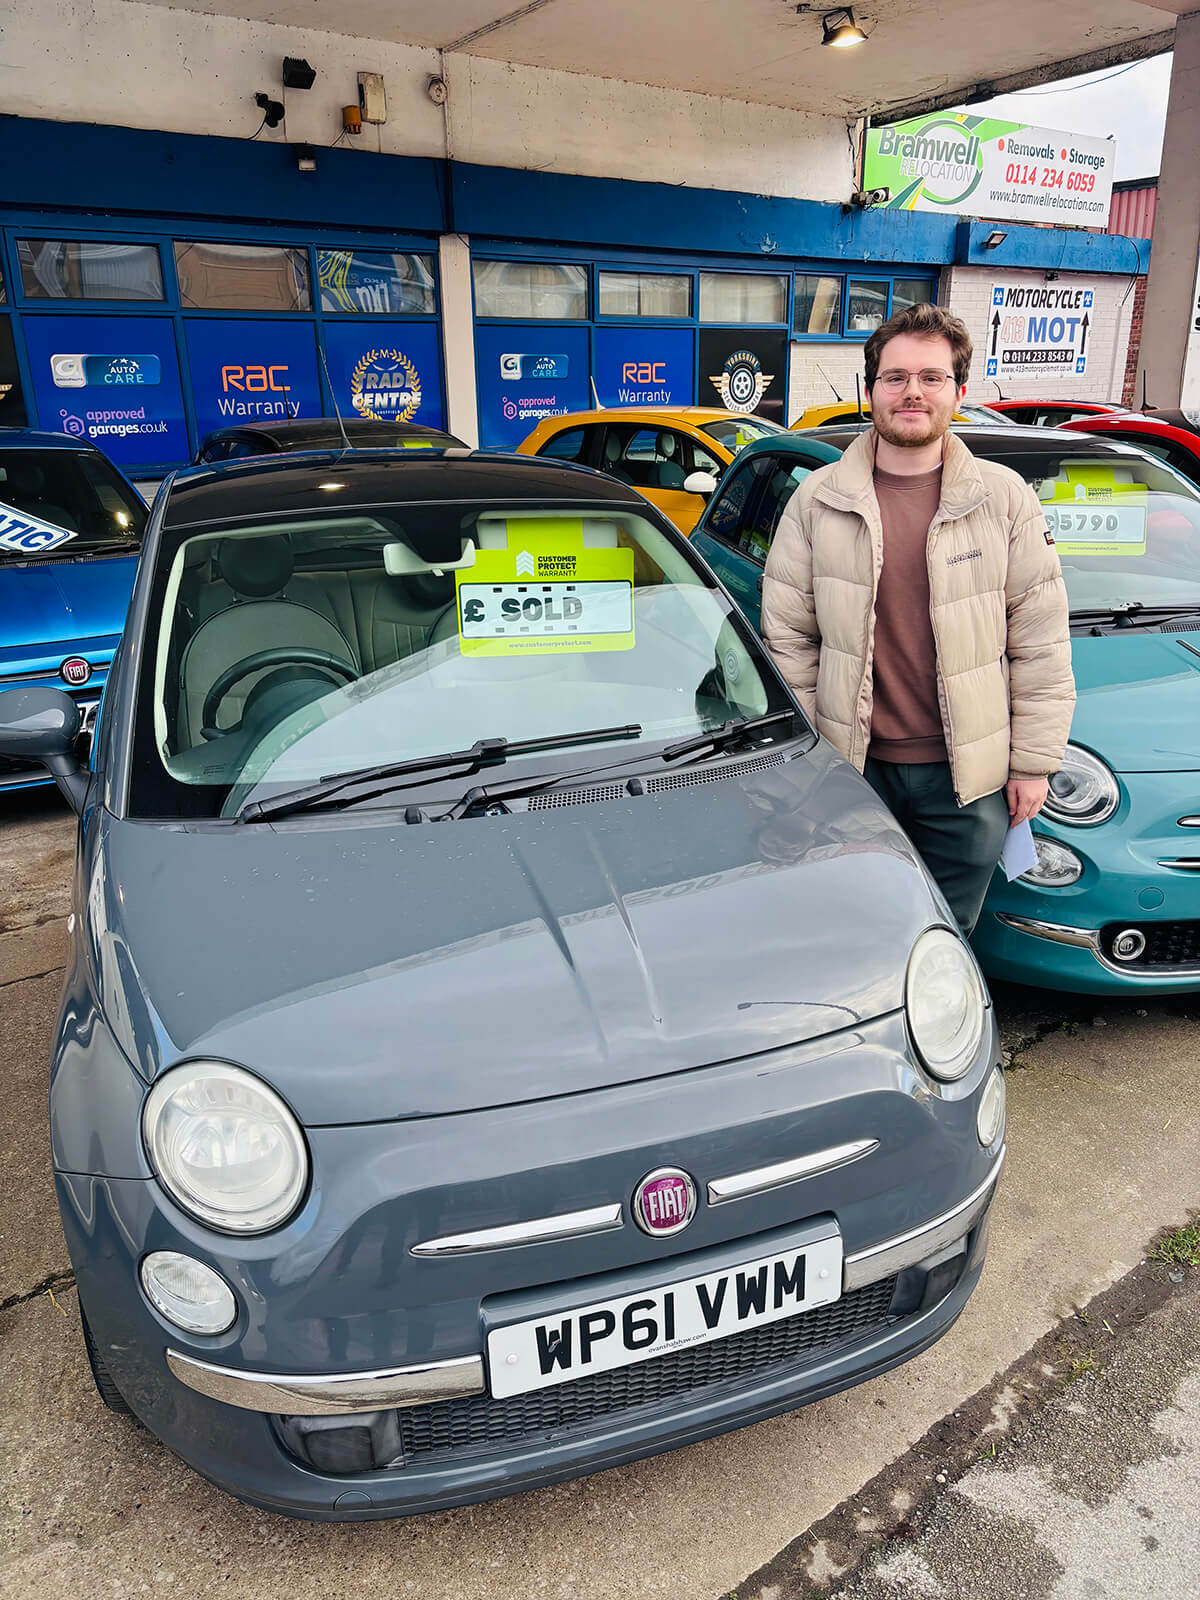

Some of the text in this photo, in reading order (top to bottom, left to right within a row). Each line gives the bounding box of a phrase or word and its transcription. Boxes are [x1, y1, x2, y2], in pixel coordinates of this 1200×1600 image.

[879, 128, 980, 165] Bramwell
[1007, 138, 1105, 170] Removals Storage
[900, 158, 972, 182] RELOCATION
[1006, 163, 1095, 193] 0114 234 6059
[989, 188, 1105, 213] www.bramwellrelocation.com
[1005, 287, 1083, 309] MOTORCYCLE
[1000, 315, 1081, 343] 413 MOT
[1011, 351, 1066, 362] 0114 233 8543
[104, 373, 145, 384] CARE
[110, 366, 136, 374] AUTO
[532, 369, 558, 377] CARE
[357, 372, 416, 390] TRADE
[352, 391, 422, 410] CENTRE
[518, 395, 556, 408] approved
[618, 388, 671, 405] Warranty
[86, 407, 145, 423] approved
[217, 398, 300, 418] Warranty
[88, 420, 168, 438] garages.co.uk
[0, 514, 54, 548] TIC
[538, 562, 577, 570] PROTECT
[464, 597, 583, 622] £ SOLD
[69, 665, 85, 679] FIAT
[648, 1184, 684, 1222] FIAT
[535, 1254, 806, 1376] WP61 VWM
